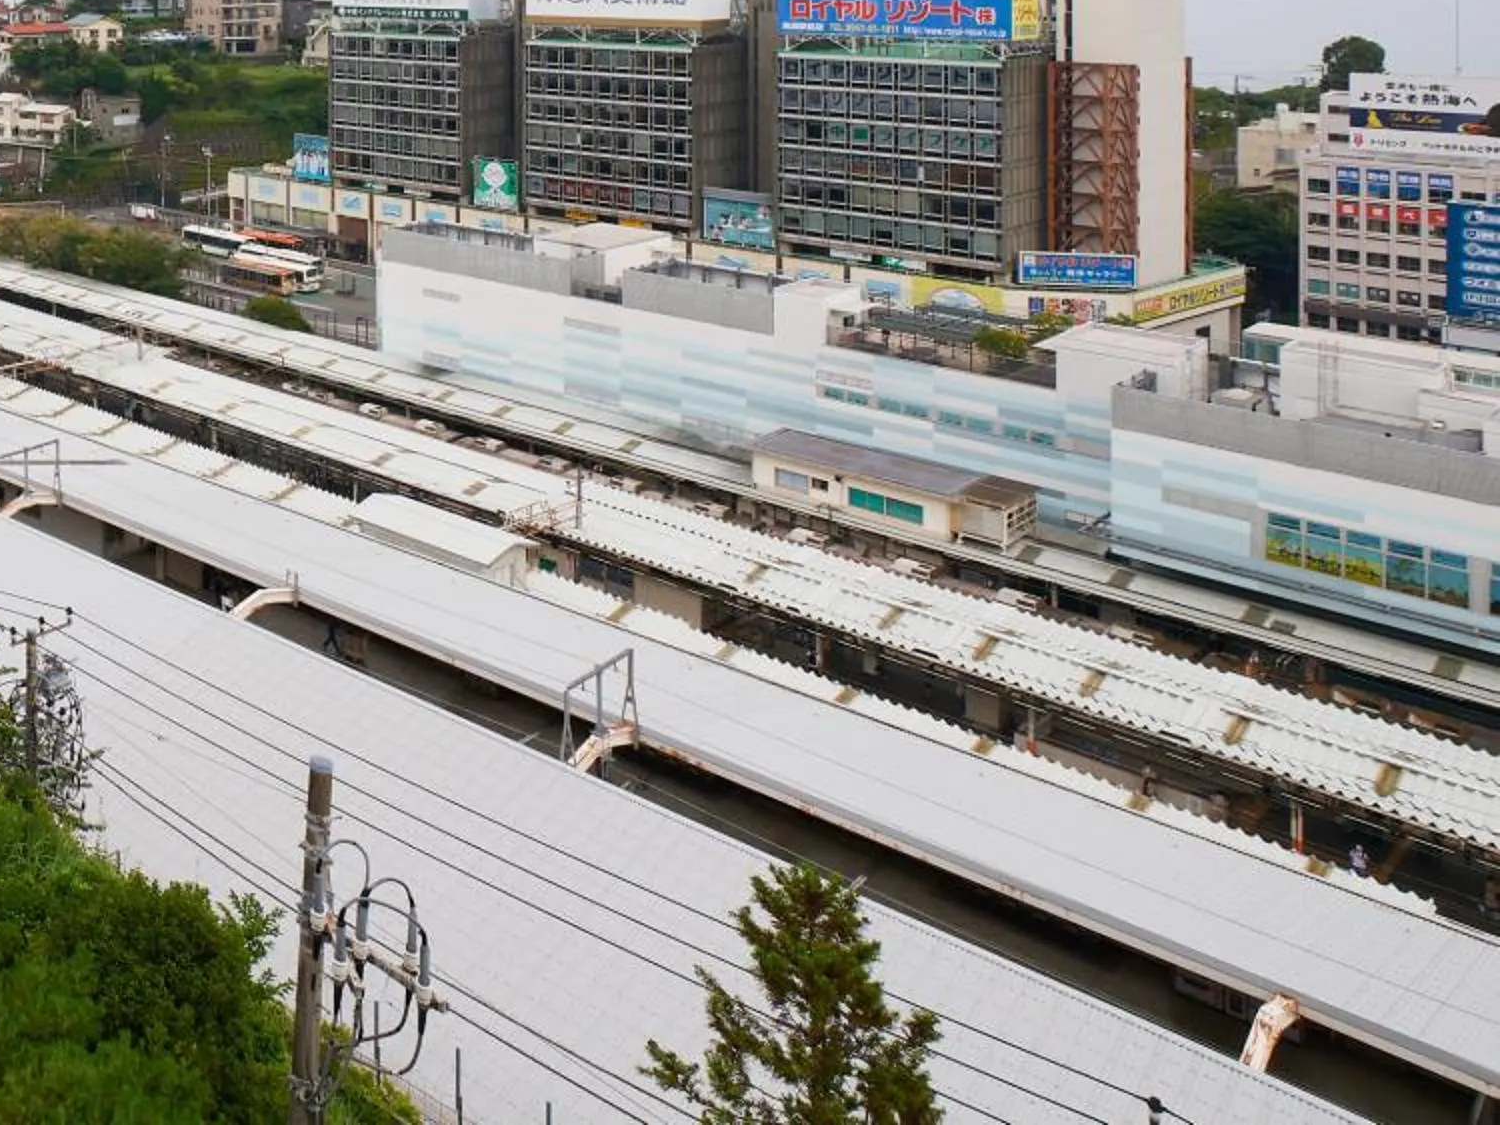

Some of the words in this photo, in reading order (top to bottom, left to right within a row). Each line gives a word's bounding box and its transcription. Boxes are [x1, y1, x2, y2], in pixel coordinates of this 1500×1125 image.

[1360, 92, 1477, 107] ようこそ熱海へ
